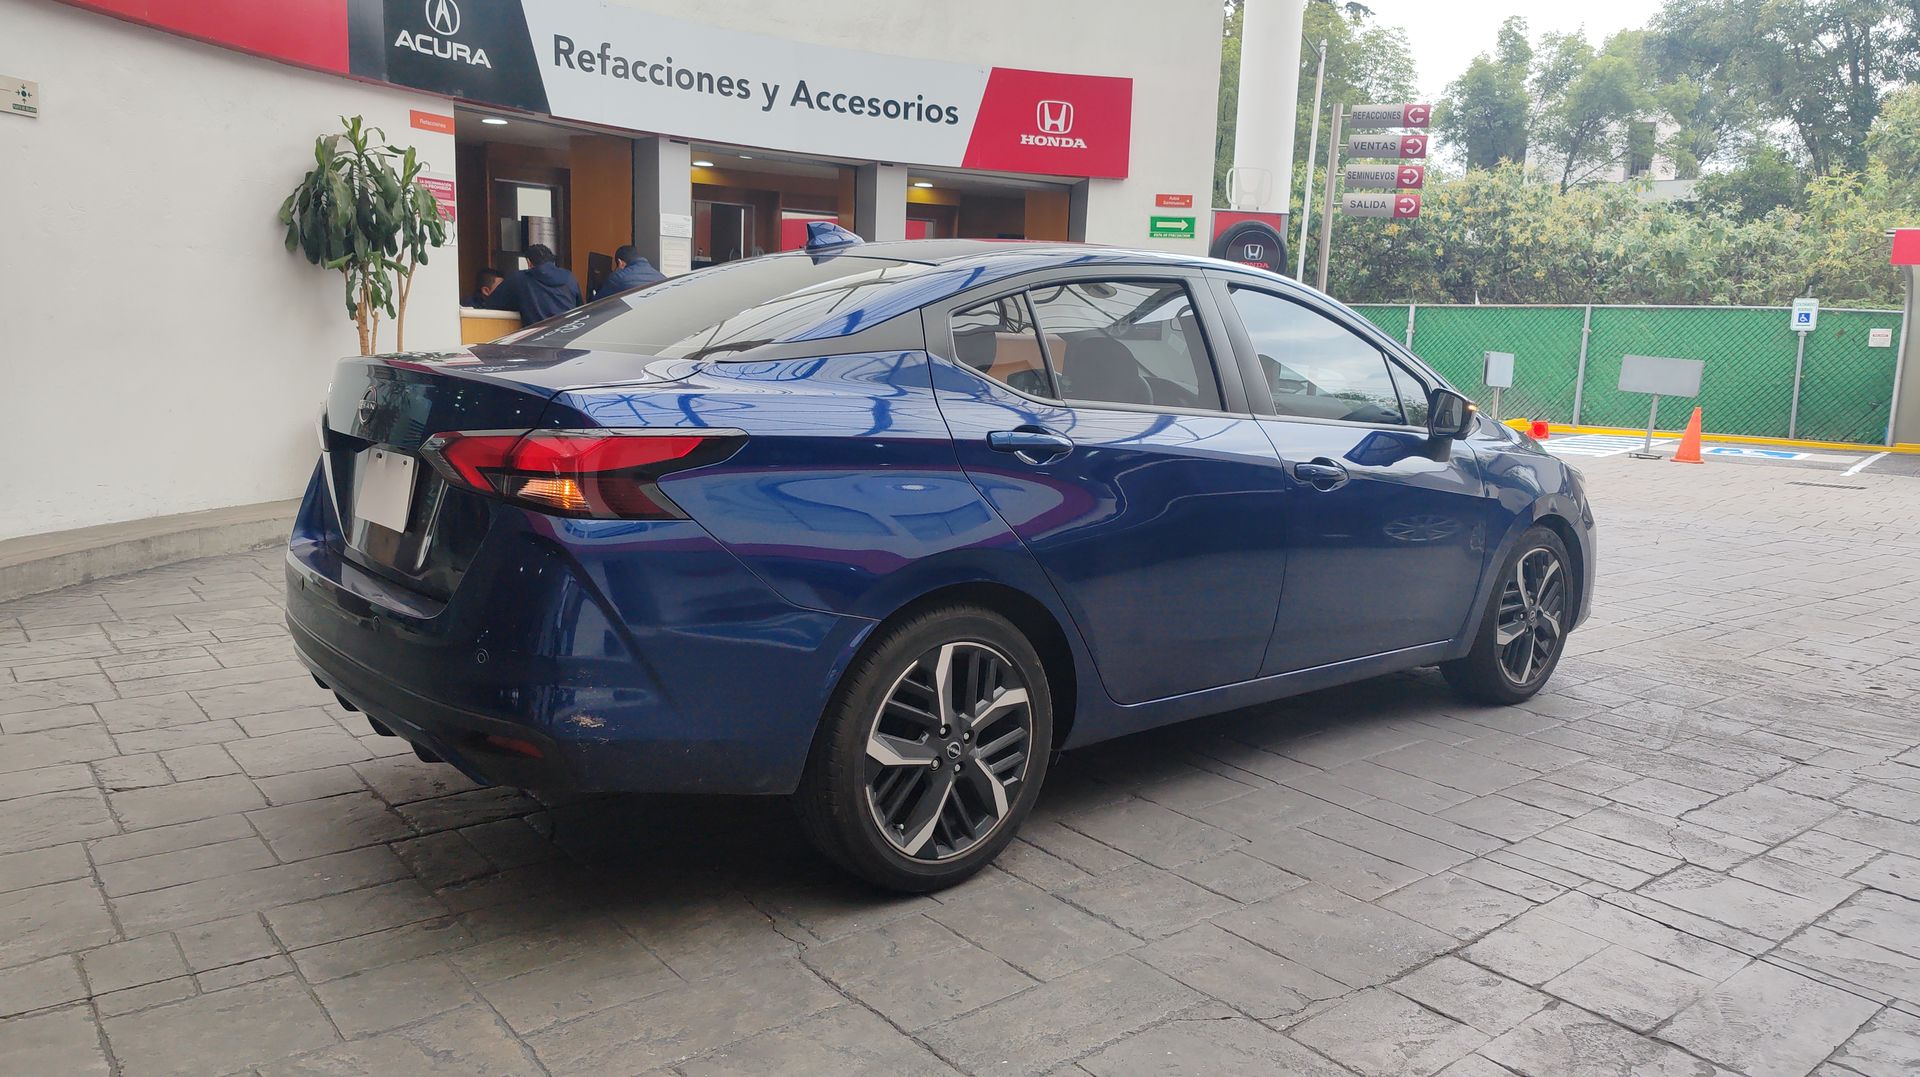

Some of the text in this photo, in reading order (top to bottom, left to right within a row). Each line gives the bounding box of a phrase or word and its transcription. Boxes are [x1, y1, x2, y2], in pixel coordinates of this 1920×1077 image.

[394, 29, 492, 69] ACURA
[553, 34, 959, 126] Refacciones y Accesorios
[1352, 111, 1401, 120] REFACCIONES
[1020, 133, 1088, 149] HONDA
[1353, 141, 1397, 151] VENTAS
[1347, 170, 1395, 181] SEMINUEVOS
[1349, 200, 1387, 209] SALIDA
